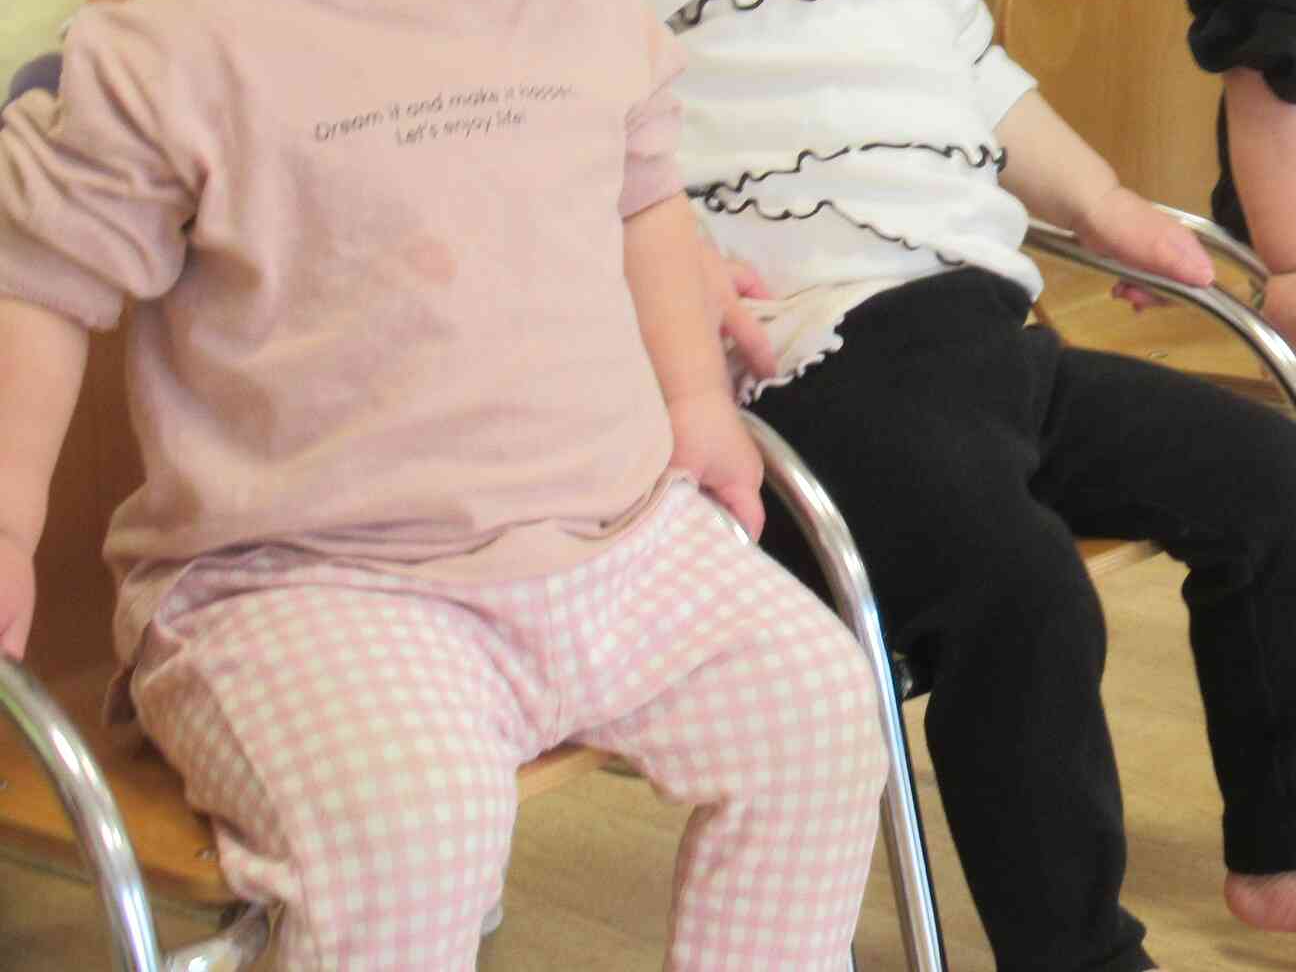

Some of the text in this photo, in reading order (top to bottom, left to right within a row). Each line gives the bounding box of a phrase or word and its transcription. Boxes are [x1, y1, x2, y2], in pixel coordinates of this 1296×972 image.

[314, 110, 384, 142] Dream
[406, 93, 443, 116] and
[449, 85, 498, 108] make
[395, 120, 439, 147] Let's
[443, 115, 493, 139] enjoy
